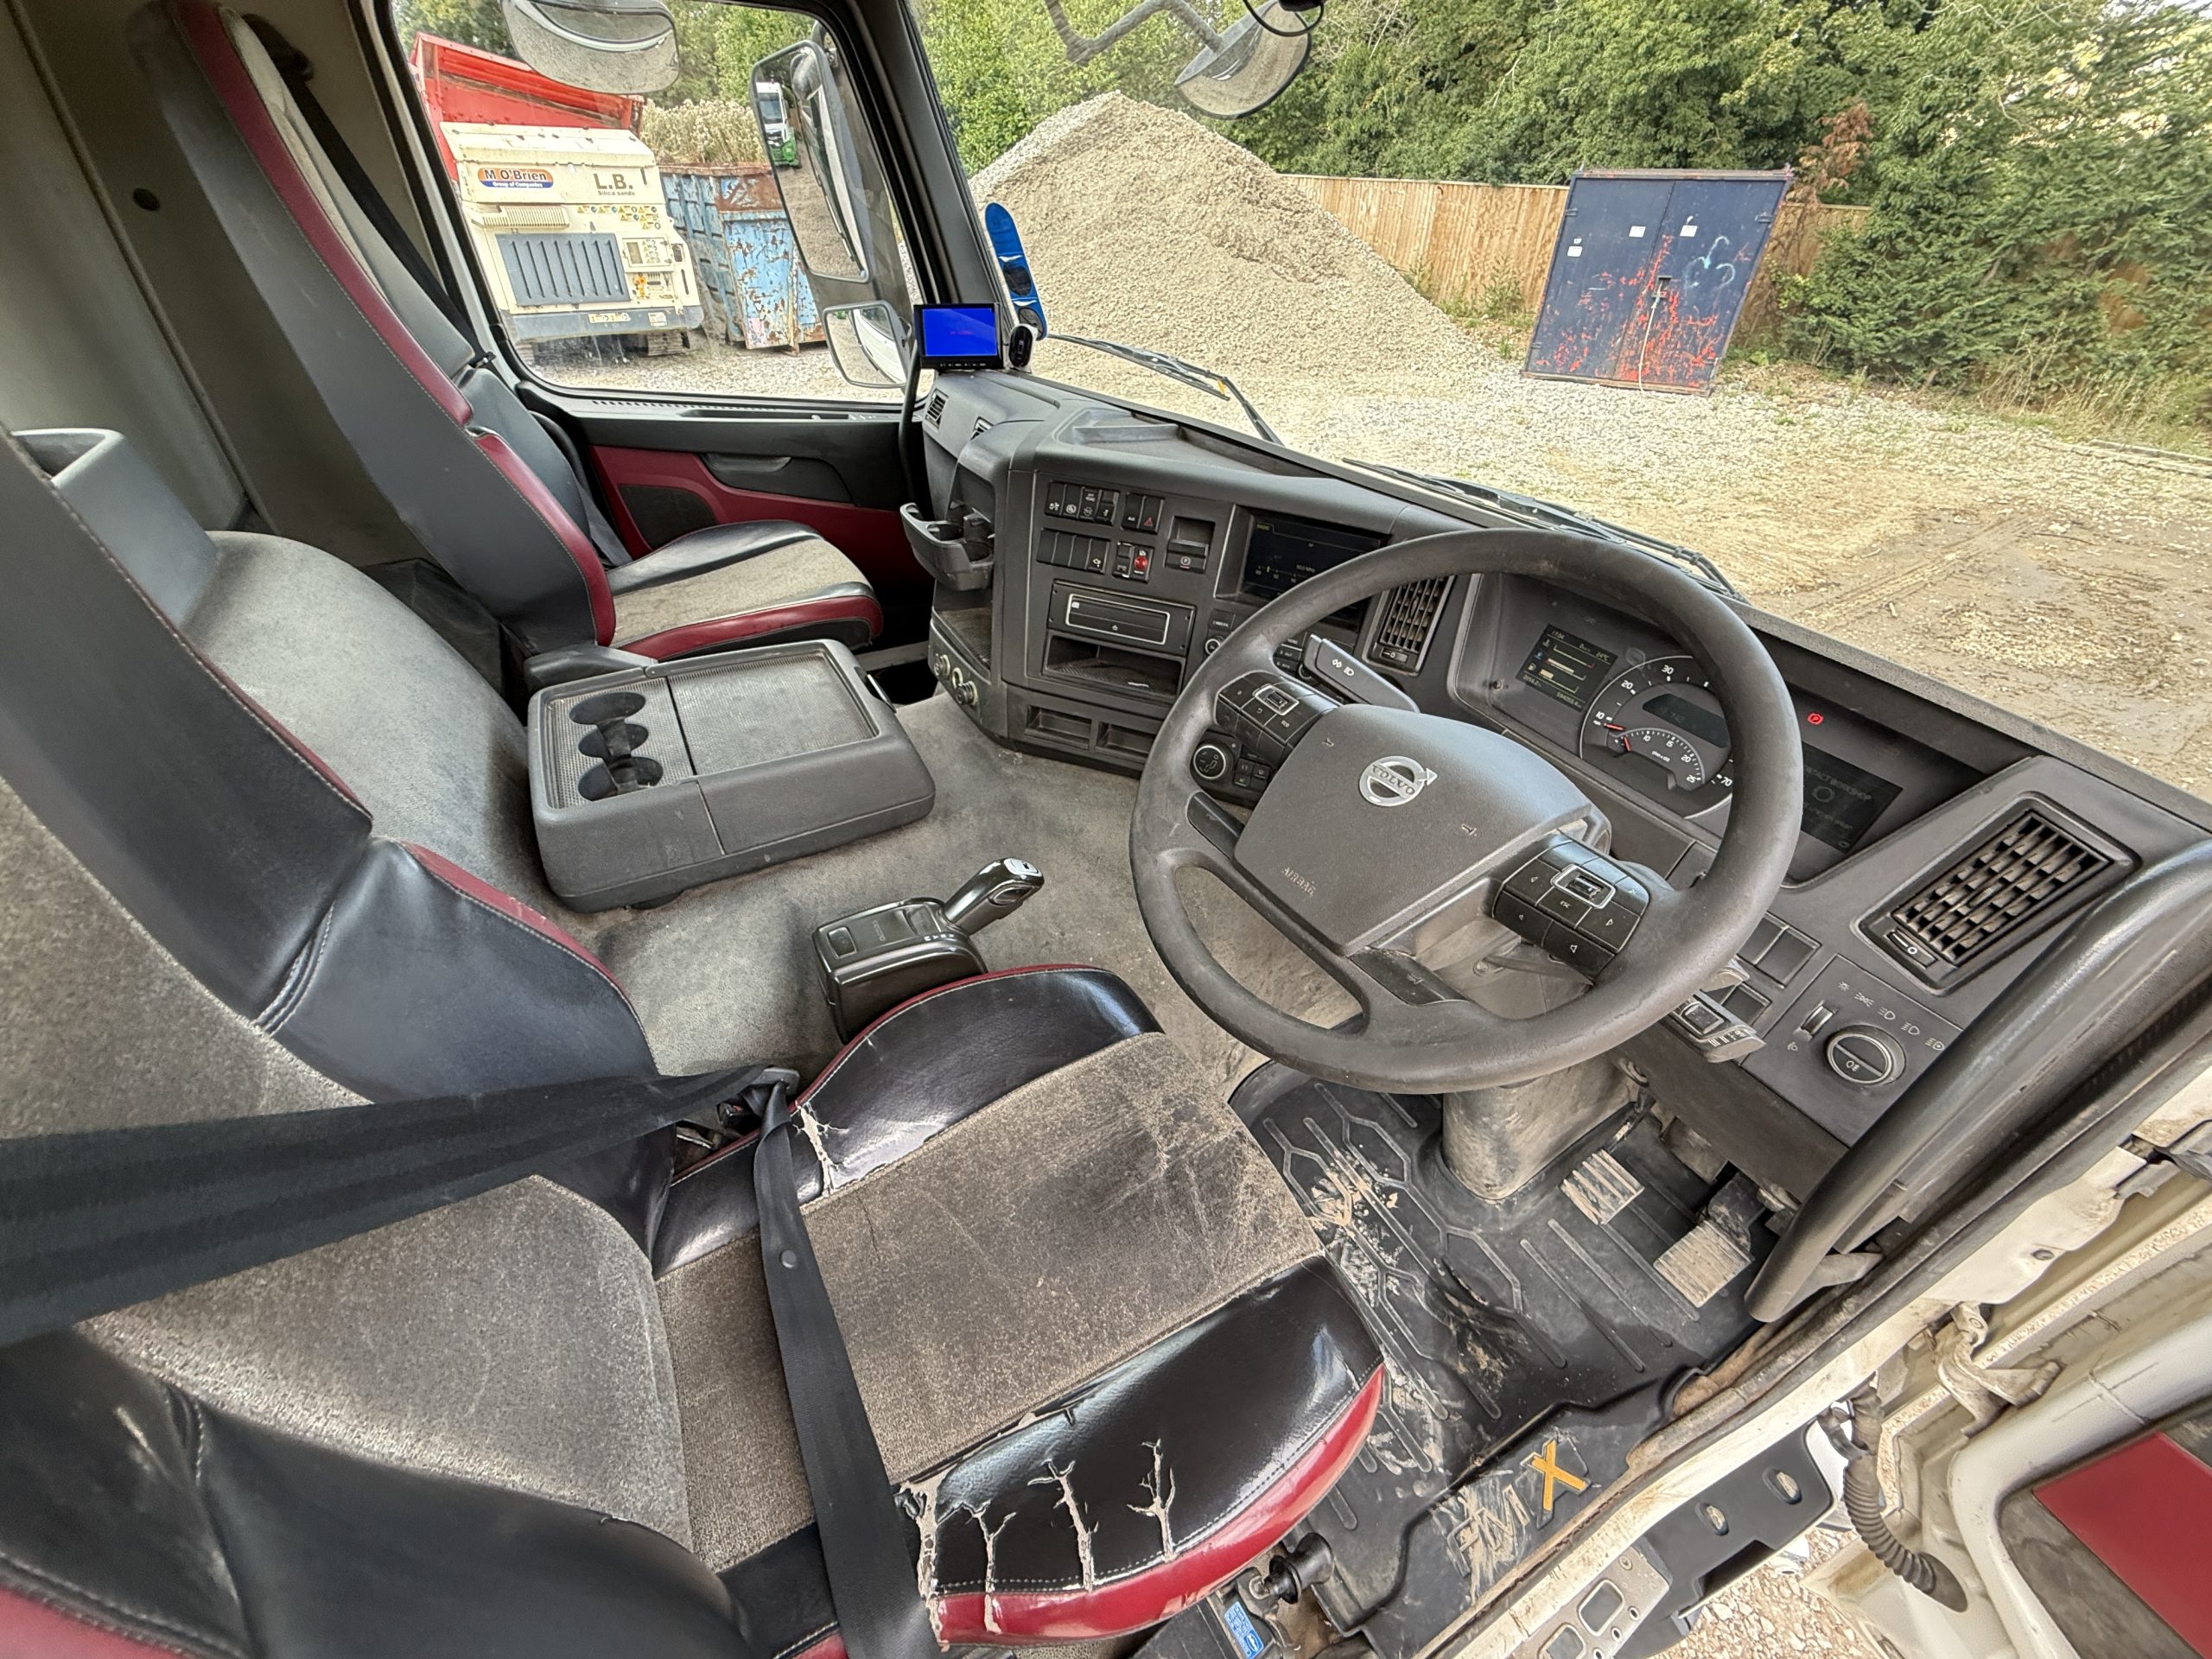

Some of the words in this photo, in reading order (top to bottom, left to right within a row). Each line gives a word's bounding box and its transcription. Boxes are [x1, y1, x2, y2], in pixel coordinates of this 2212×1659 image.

[484, 169, 496, 180] M
[499, 169, 547, 181] O'Brien
[593, 173, 633, 189] L.B.
[1661, 664, 1675, 675] 30
[1621, 680, 1634, 690] 20
[1595, 711, 1605, 720] 10
[1681, 754, 1692, 763] 20
[1372, 765, 1415, 795] VOLVO
[1686, 774, 1697, 784] 25
[1720, 776, 1733, 787] 70
[1282, 867, 1315, 896] AIRBAG
